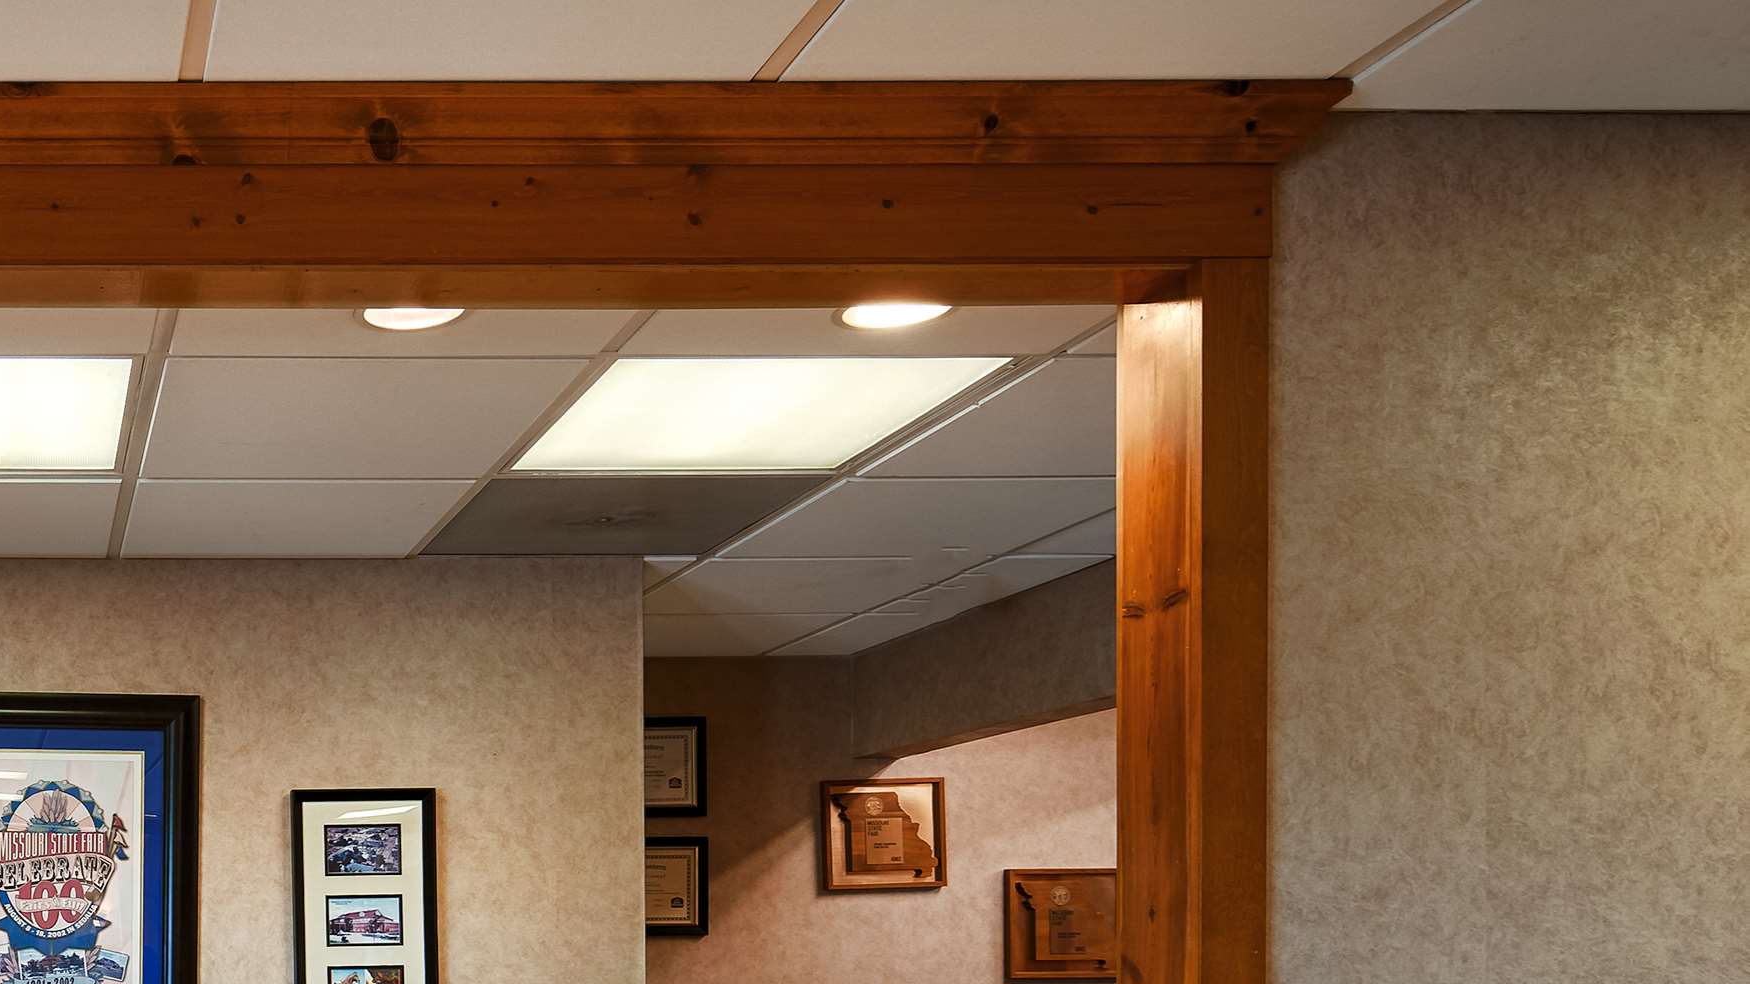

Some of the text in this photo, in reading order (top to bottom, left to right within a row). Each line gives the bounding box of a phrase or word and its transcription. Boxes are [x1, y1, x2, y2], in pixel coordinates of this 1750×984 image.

[51, 832, 79, 854] STATE
[81, 832, 104, 854] FAIR
[4, 904, 26, 928] AUGUST
[47, 930, 67, 938] 2002
[67, 926, 75, 934] IN
[75, 904, 98, 930] SEDALIA
[16, 880, 85, 930] 100
